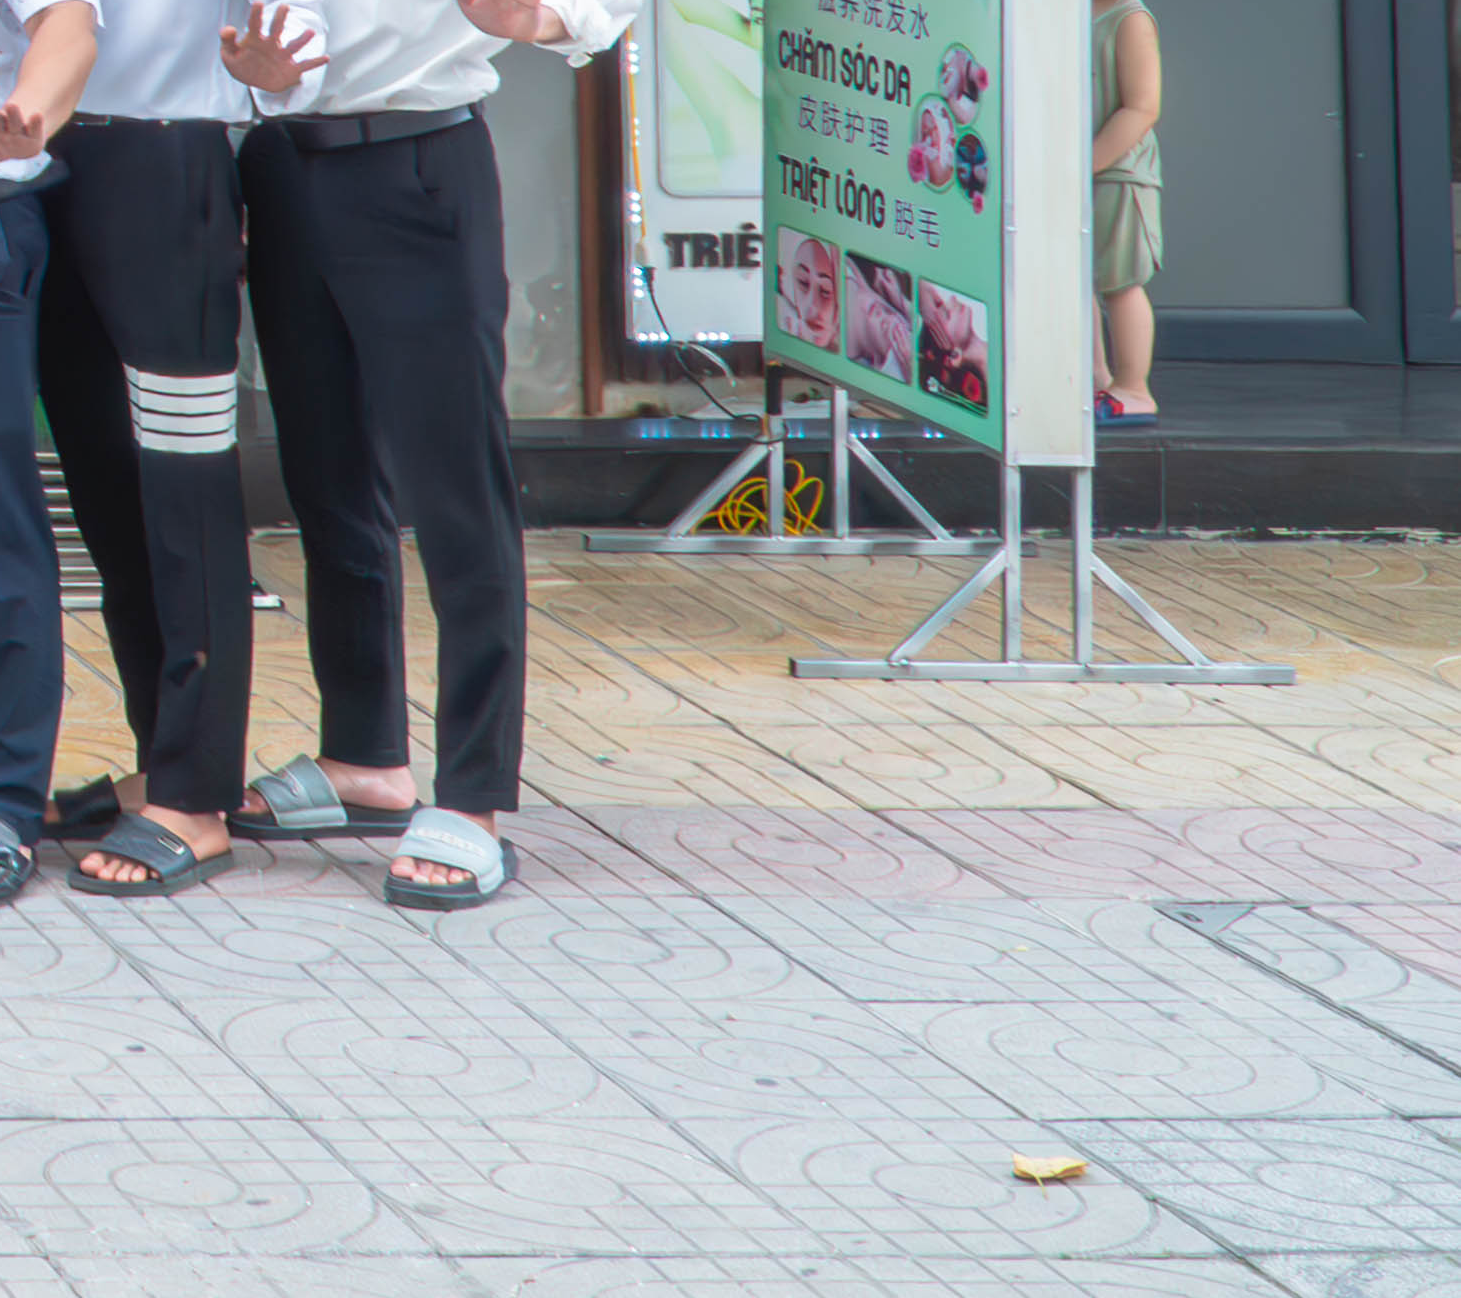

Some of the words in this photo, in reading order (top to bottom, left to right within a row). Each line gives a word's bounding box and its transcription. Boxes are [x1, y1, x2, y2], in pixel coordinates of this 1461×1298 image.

[779, 26, 836, 84] CHĂM
[840, 42, 880, 96] SÓC
[883, 58, 911, 107] DA
[798, 94, 890, 156] 皮肤护理
[778, 155, 832, 214] TRIỆT
[836, 168, 885, 229] LÔNG
[895, 199, 940, 248] 脱毛
